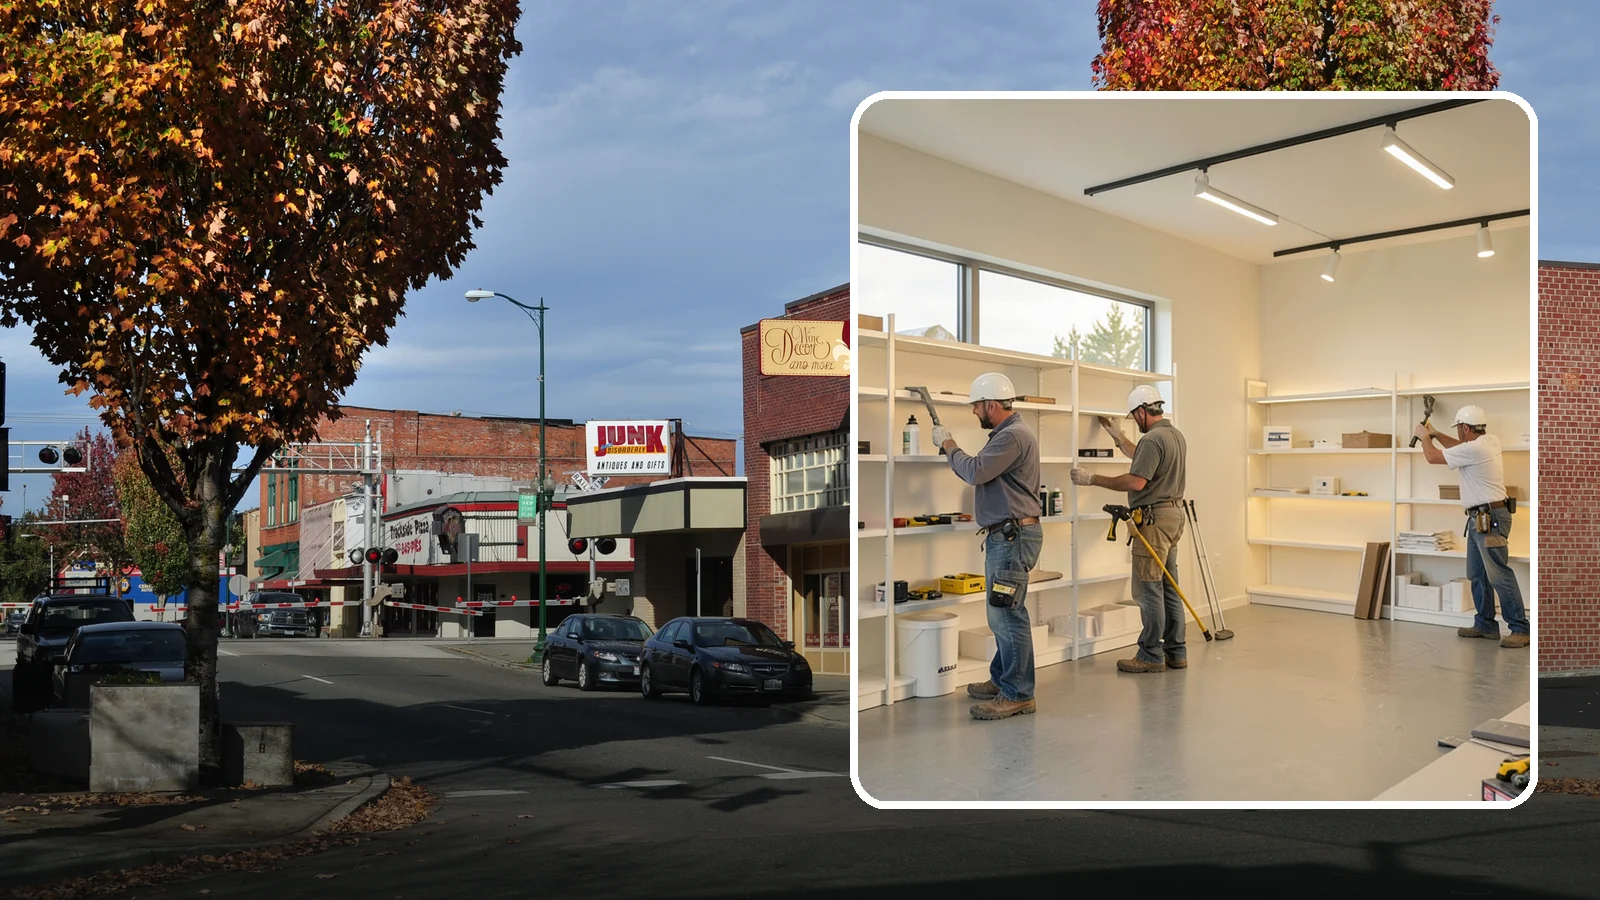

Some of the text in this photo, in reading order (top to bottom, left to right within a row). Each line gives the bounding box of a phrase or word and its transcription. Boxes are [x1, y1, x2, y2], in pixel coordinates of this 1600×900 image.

[595, 425, 665, 457] JUNK
[607, 446, 646, 454] DISORDERLY
[597, 460, 665, 470] ANTIQUES AND GIFTS
[573, 473, 589, 493] RAIL
[414, 519, 429, 535] Pizza
